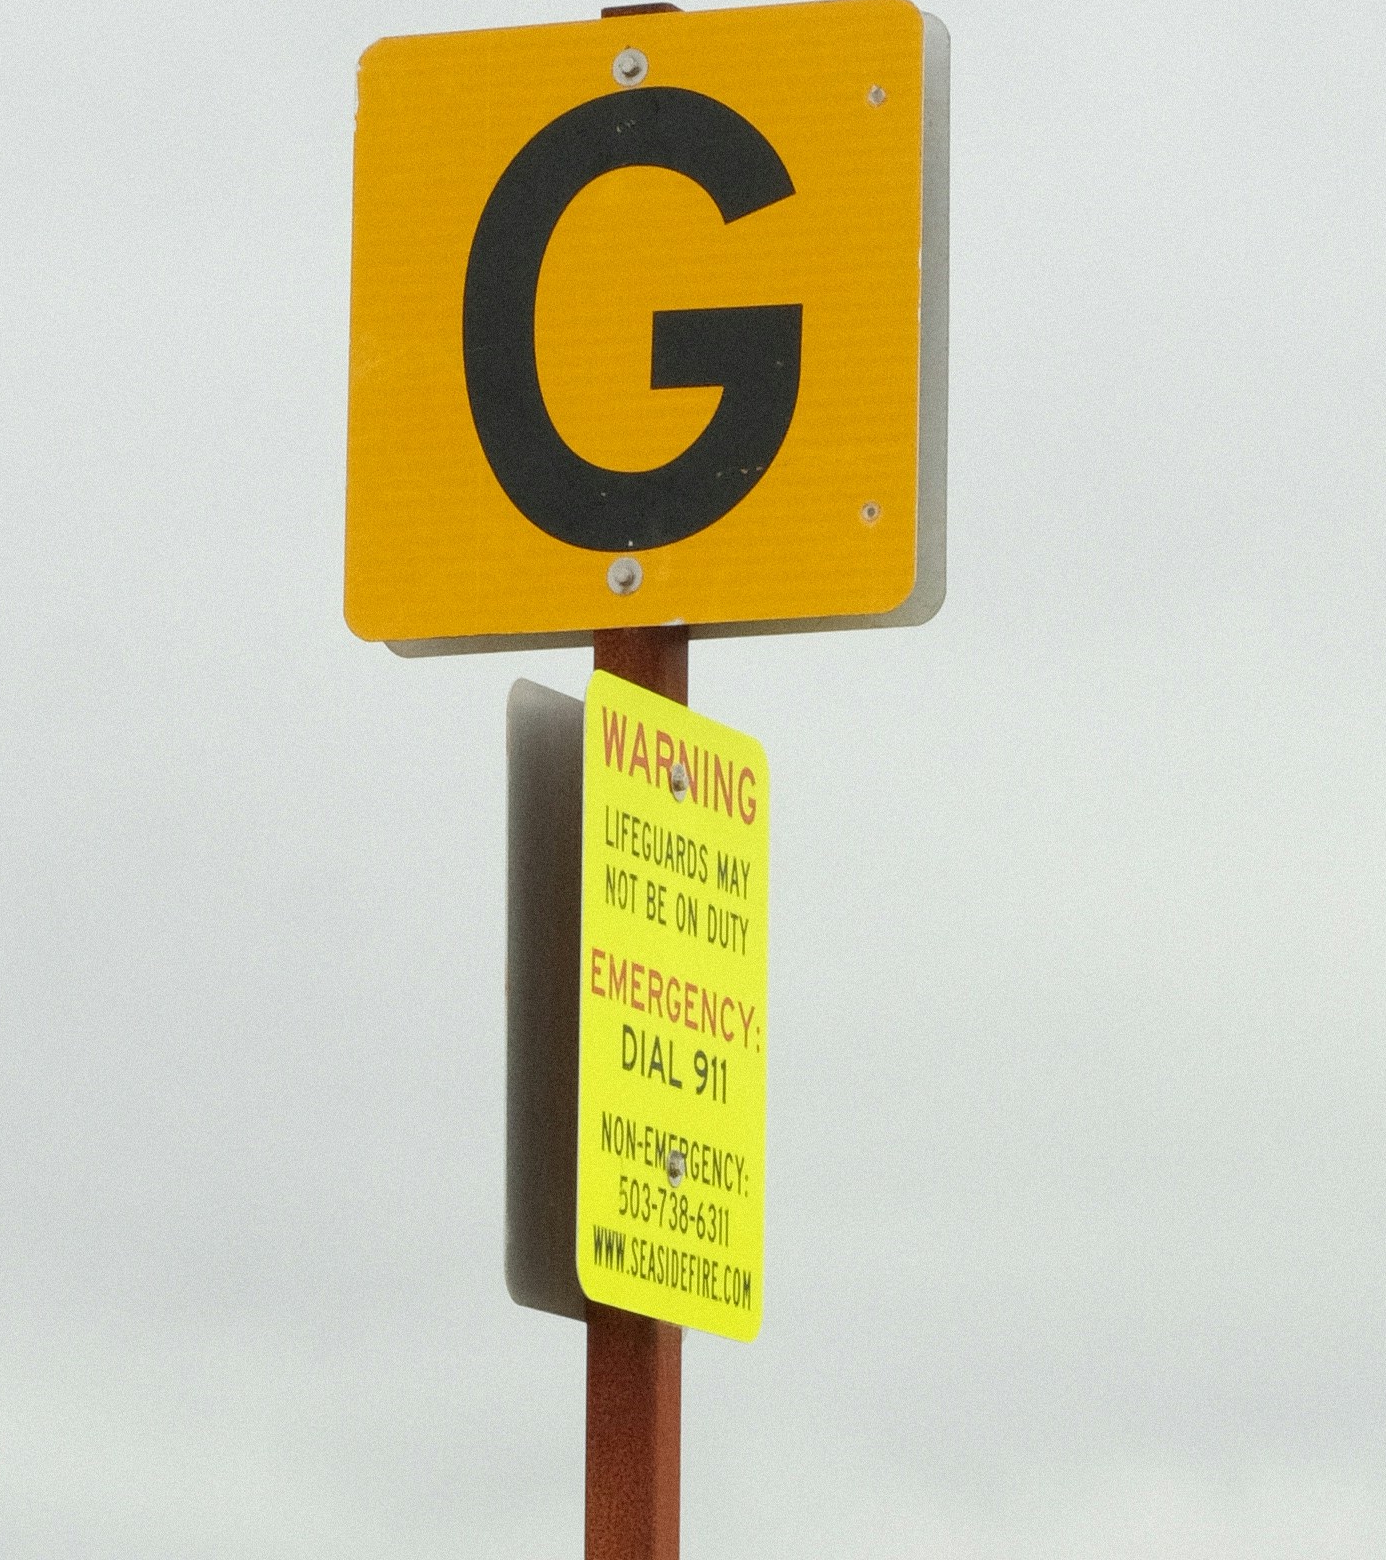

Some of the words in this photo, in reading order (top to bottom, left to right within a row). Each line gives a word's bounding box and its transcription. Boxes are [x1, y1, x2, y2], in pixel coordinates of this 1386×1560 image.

[462, 86, 803, 553] G
[602, 705, 757, 825] WARNING
[605, 805, 708, 884] LIFEGUARDS
[717, 850, 751, 900] MAY
[605, 864, 638, 914] NOT
[646, 880, 667, 925] BE
[676, 892, 698, 937] ON
[708, 904, 749, 955] DUTY
[591, 946, 760, 1053] EMERGENCY:
[622, 1024, 683, 1089] DIAL
[694, 1049, 728, 1104] 911
[618, 1175, 730, 1248] 503-738-6311
[593, 1224, 752, 1311] WWW.SEASIDEFIRE.COM
